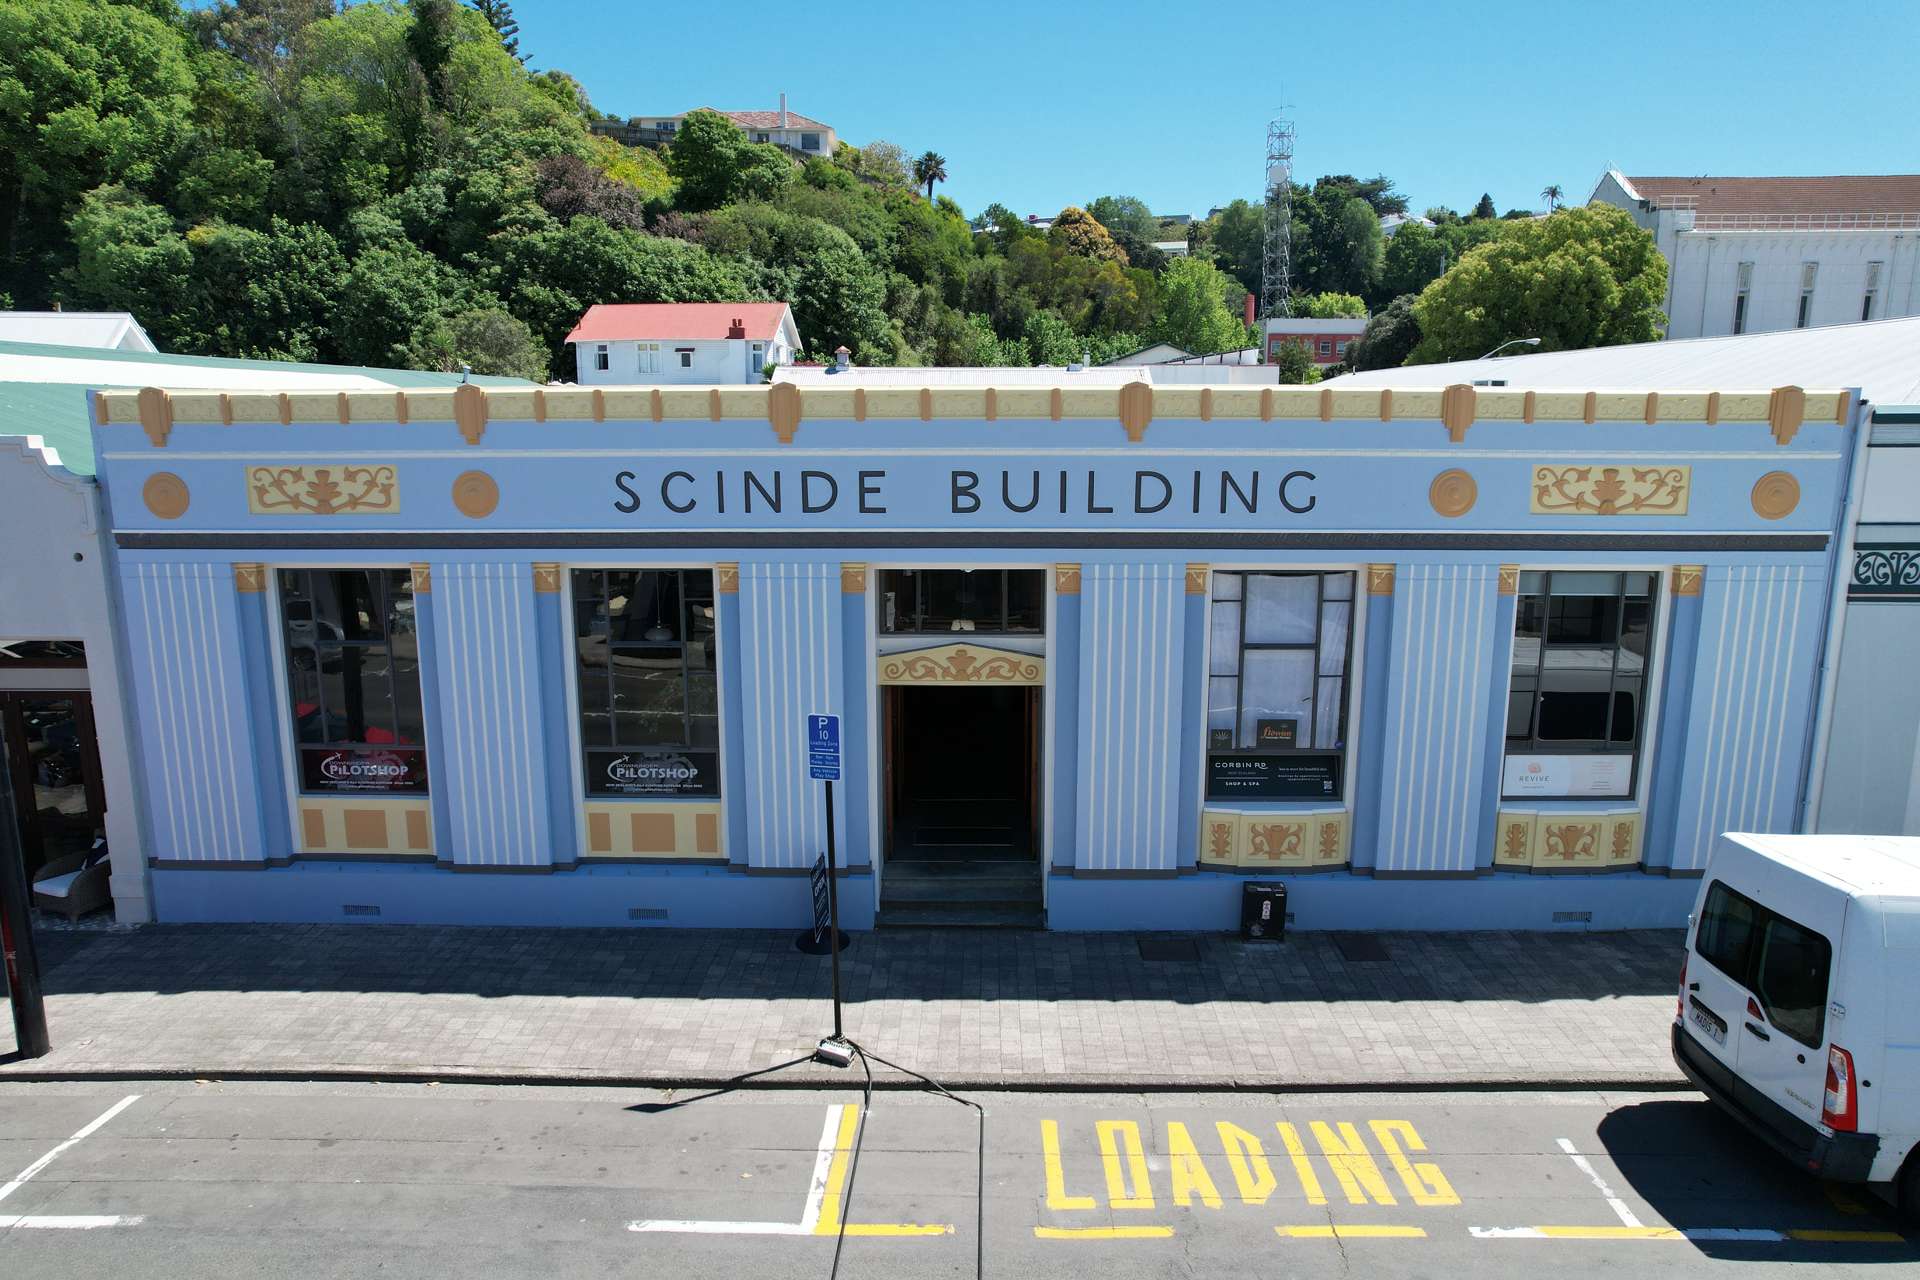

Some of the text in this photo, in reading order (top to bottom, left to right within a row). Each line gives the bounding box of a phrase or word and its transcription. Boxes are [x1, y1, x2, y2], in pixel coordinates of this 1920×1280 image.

[614, 470, 1317, 514] SCINDE BUILDING
[818, 717, 828, 730] P
[819, 730, 829, 741] 10
[1041, 1119, 1462, 1209] LOADING
